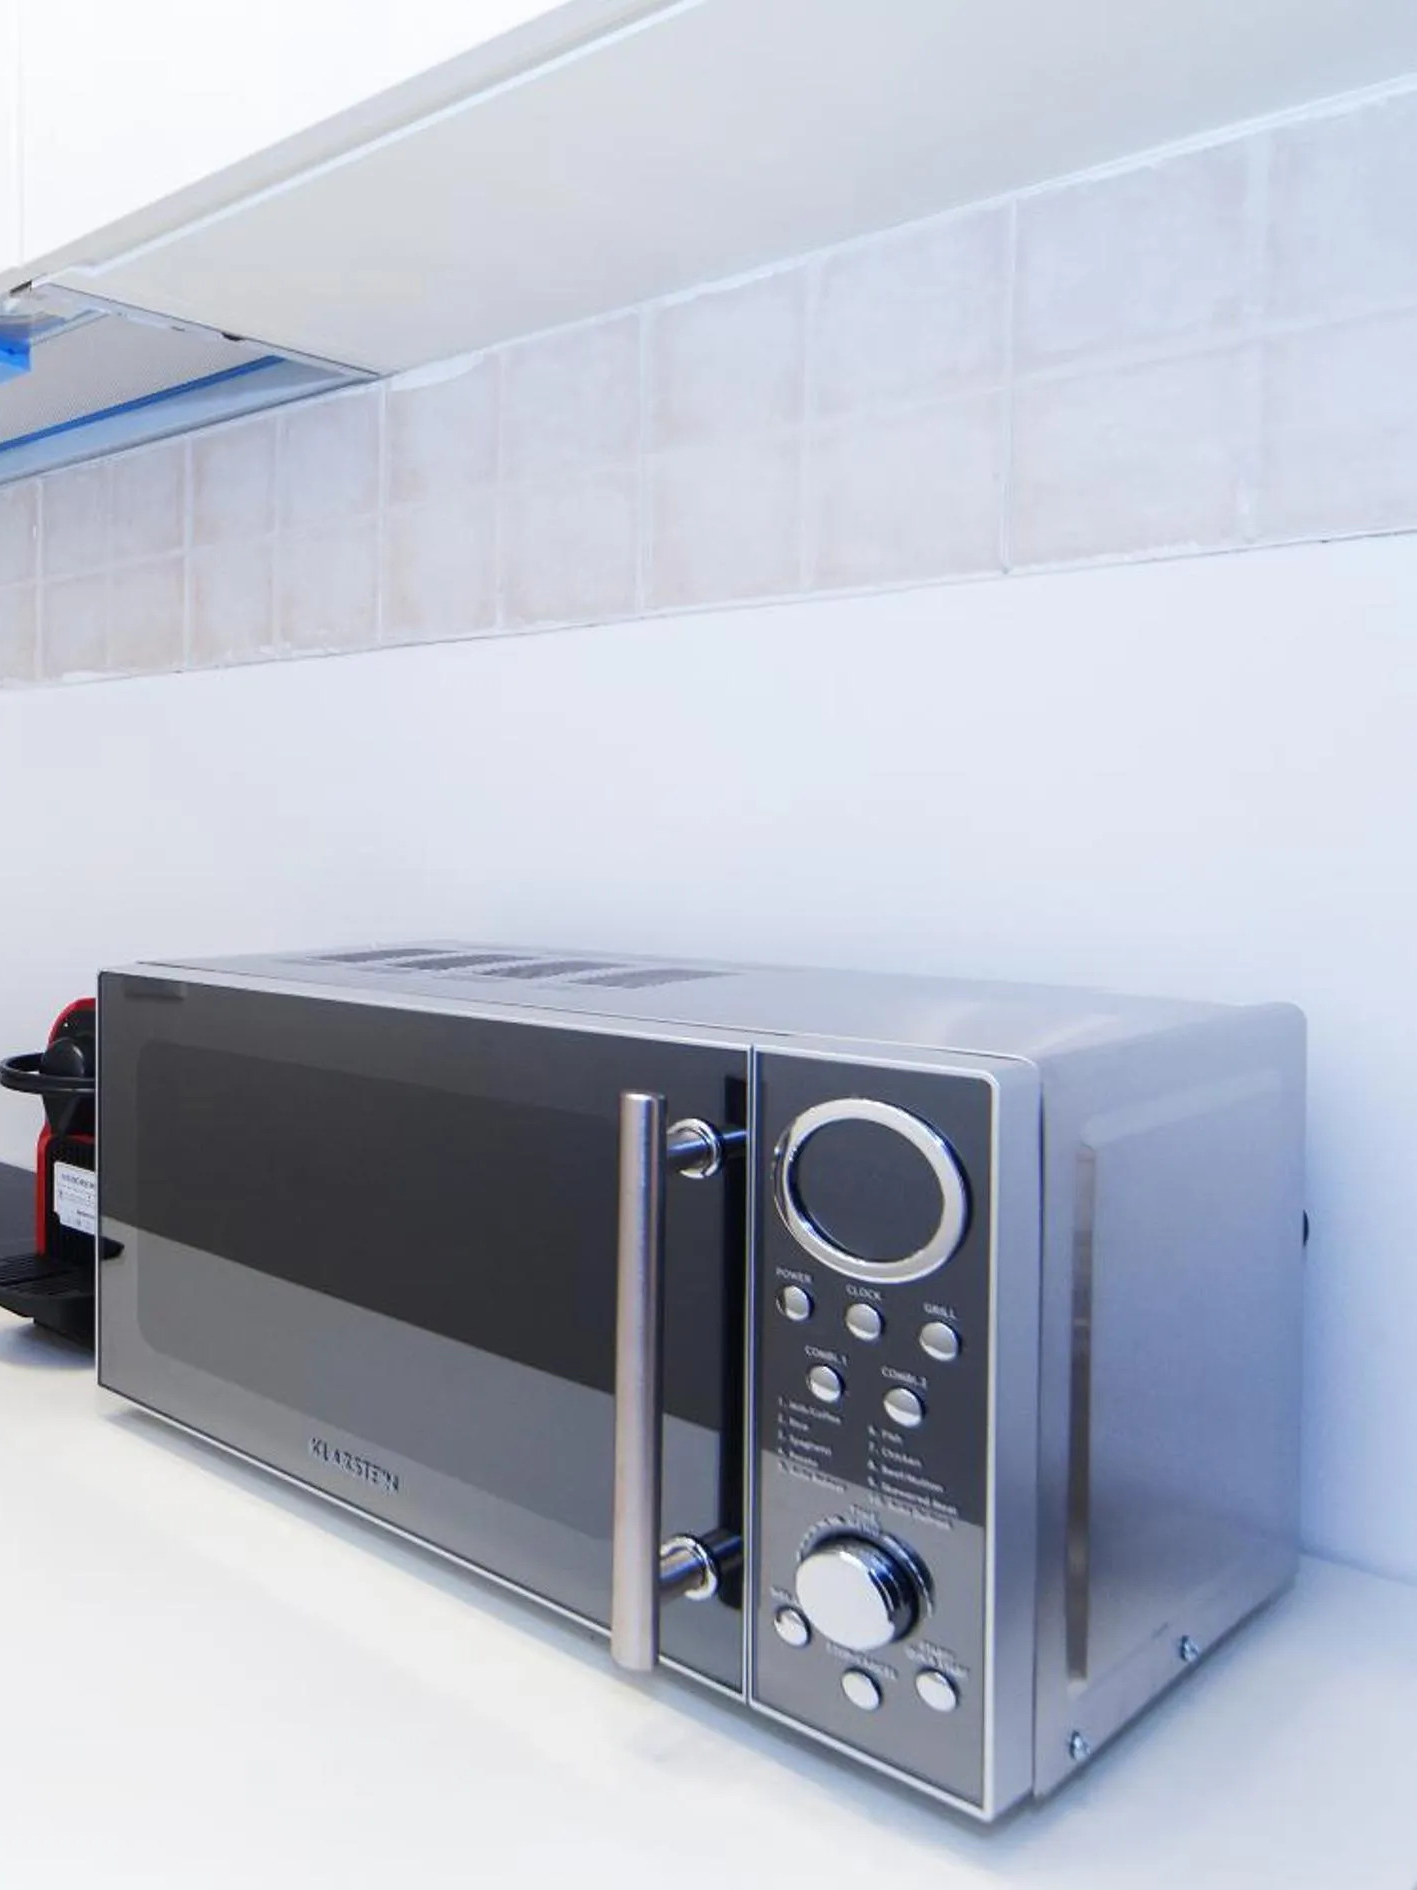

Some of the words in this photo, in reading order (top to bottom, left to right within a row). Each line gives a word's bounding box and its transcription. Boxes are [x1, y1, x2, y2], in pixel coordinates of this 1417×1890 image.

[776, 1267, 812, 1284] POWER
[845, 1283, 882, 1301] CLOCK
[311, 1437, 399, 1492] KLARSTEIN
